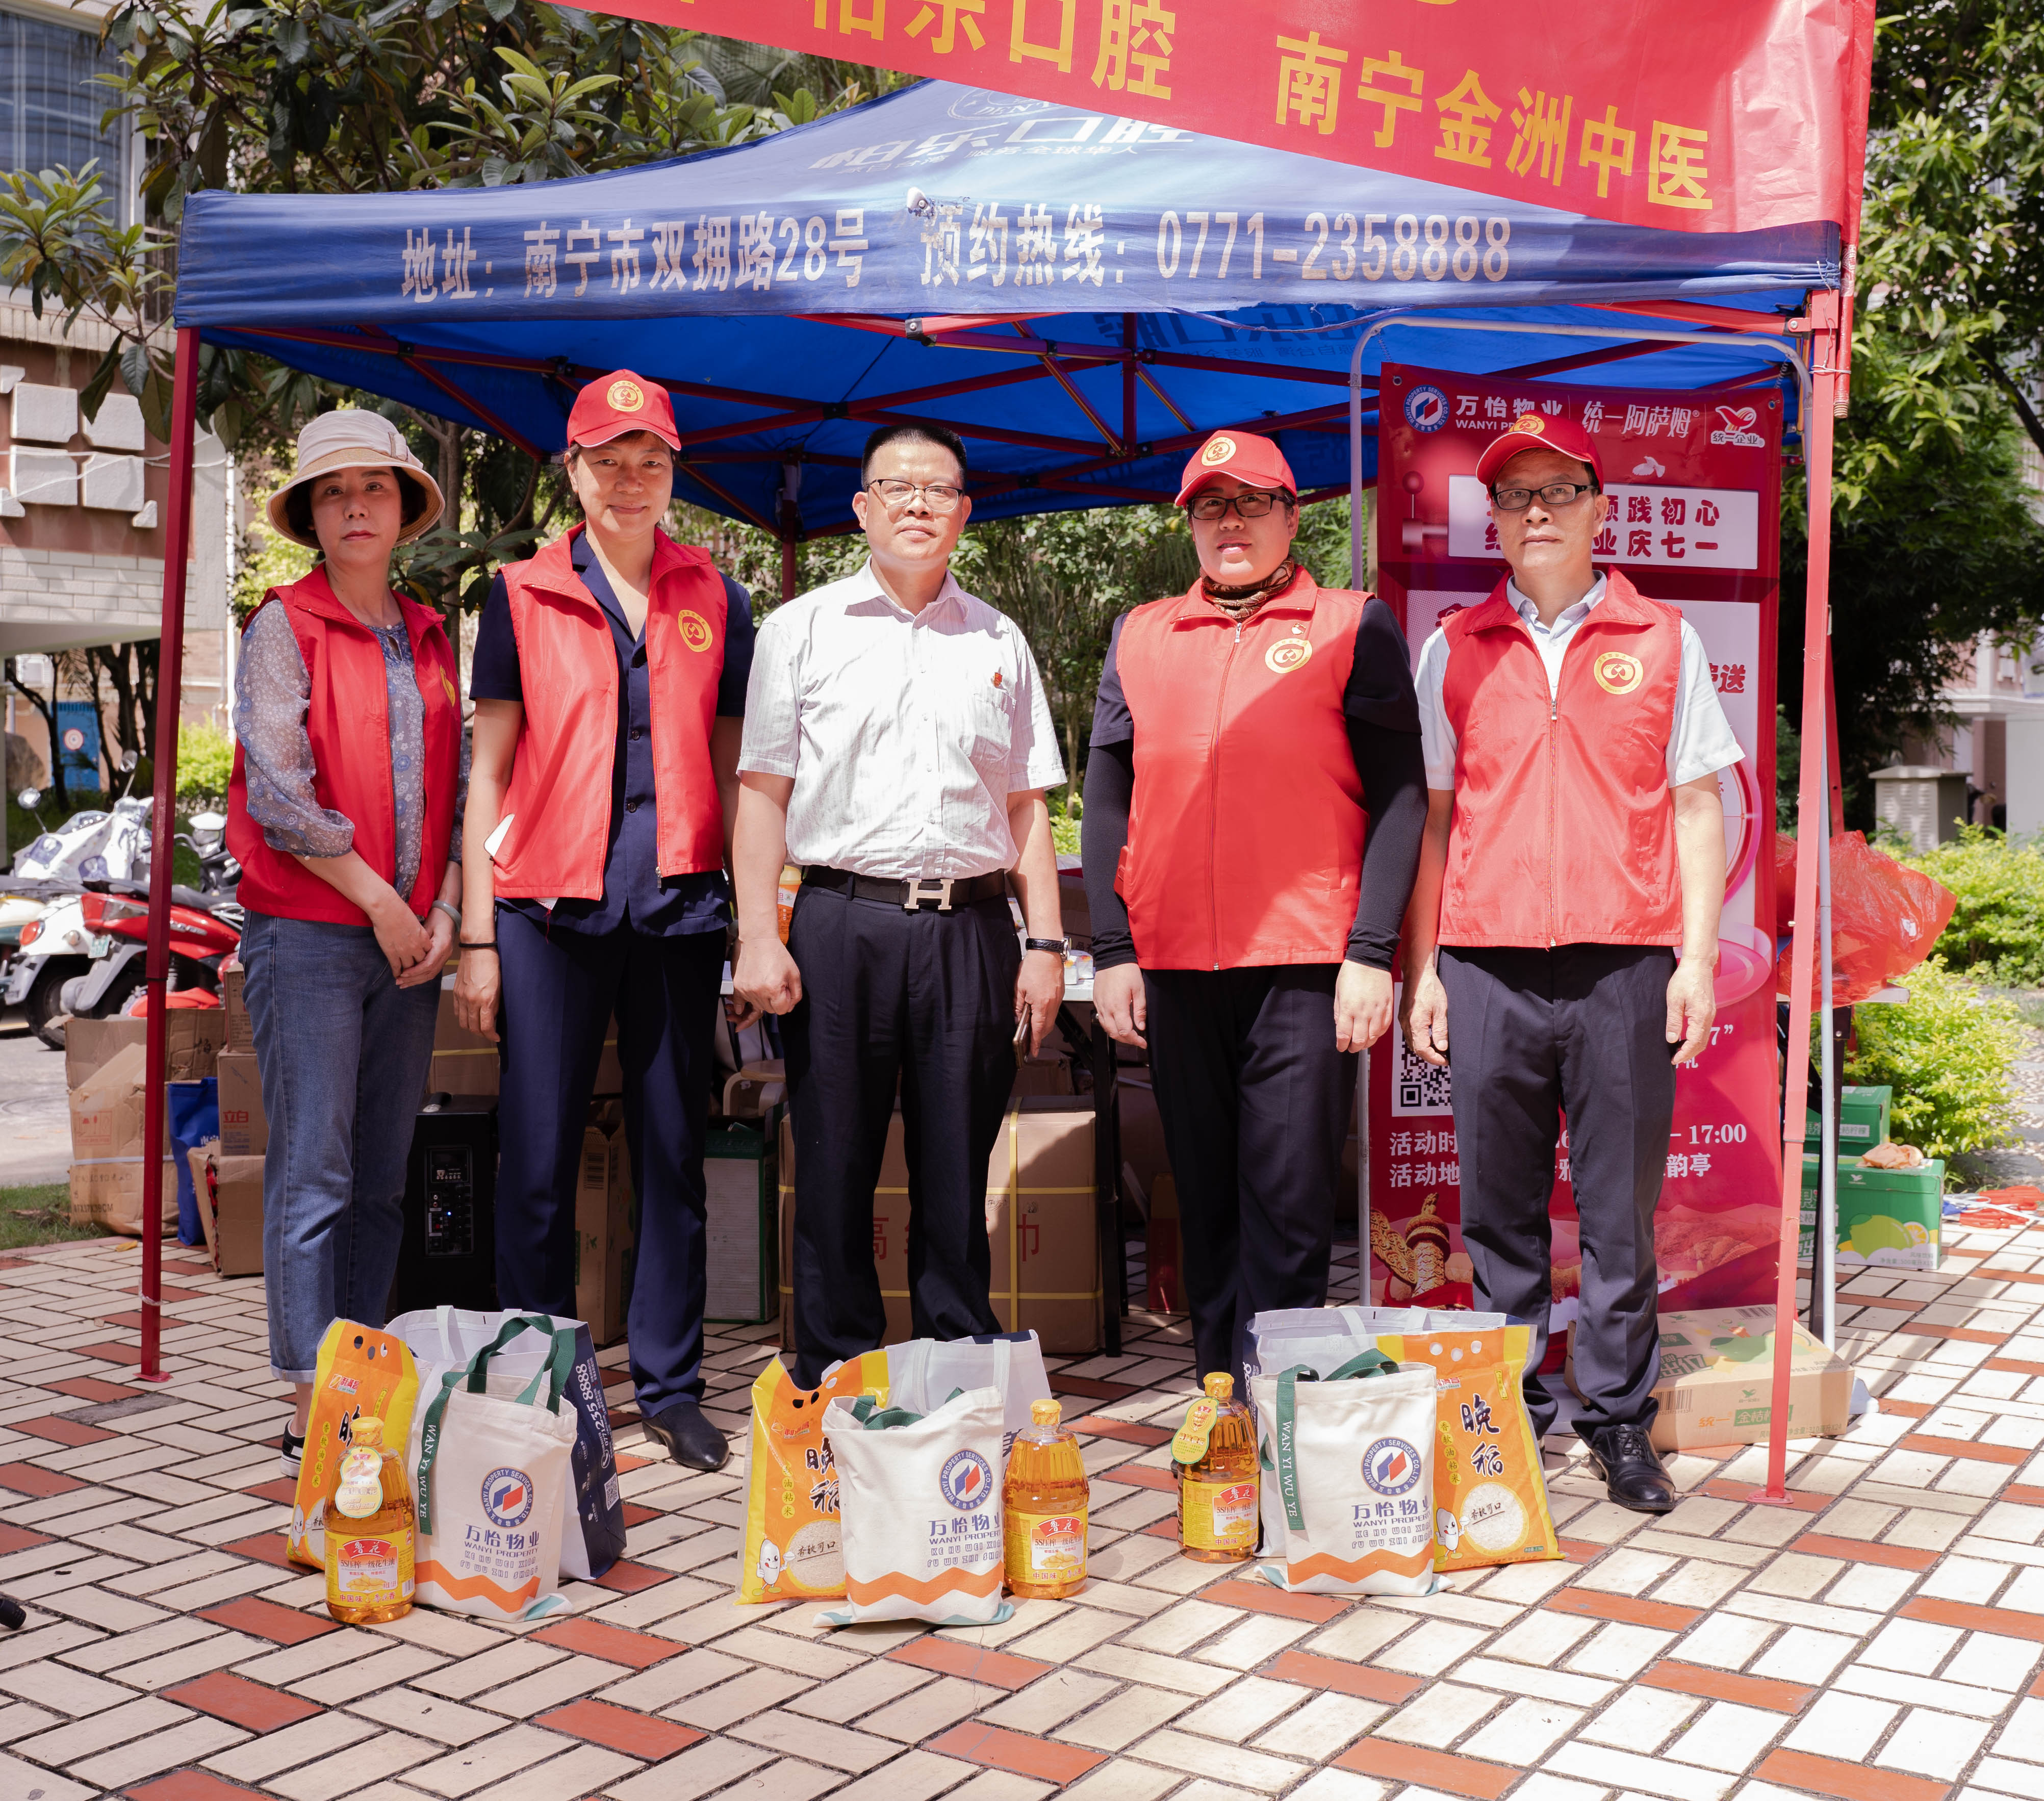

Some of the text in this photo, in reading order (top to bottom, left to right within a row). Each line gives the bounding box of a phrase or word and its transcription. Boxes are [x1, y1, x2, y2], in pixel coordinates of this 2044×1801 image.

[1275, 31, 1714, 210] 南宁金洲中医
[523, 208, 870, 298] 南宁市双拥路28号
[1157, 210, 1512, 282] 0771-2358888
[1406, 387, 1427, 406] PROPERTY
[1427, 387, 1447, 406] SERVICES
[1455, 419, 1497, 431] WANYI
[1581, 400, 1692, 439] 统一阿萨姆
[1711, 432, 1758, 446] 统一企业
[223, 1111, 249, 1123] 立白
[1689, 1123, 1747, 1144] 17:00
[575, 1363, 594, 1401] 8888
[1698, 1416, 1730, 1428] 统一
[1460, 1393, 1504, 1477] 晚稻
[1364, 1441, 1387, 1468] PROPERTY
[1388, 1439, 1416, 1459] SERVICES
[1440, 1422, 1461, 1482] 香软油粘米
[419, 1424, 437, 1518] WAN YI WU YE
[942, 1452, 965, 1479] PROPERTY
[965, 1451, 988, 1472] SERVICES
[1282, 1420, 1298, 1517] WAN YI WU YE
[484, 1469, 509, 1490] PROPERTY
[510, 1470, 532, 1493] SERVICES
[1364, 1469, 1378, 1489] WANYI
[941, 1481, 954, 1502] WANYI
[1230, 1486, 1252, 1500] 鲁花
[482, 1490, 492, 1513] WANYI
[1471, 1502, 1501, 1520] 香软可口
[1048, 1519, 1074, 1532] 鲁花
[1353, 1519, 1387, 1528] WANYI
[1392, 1526, 1412, 1535] WEI
[465, 1524, 540, 1550] 万怡物业
[929, 1536, 961, 1546] WANYI
[1215, 1537, 1238, 1546] 中国味
[1369, 1539, 1385, 1547] WU
[1389, 1537, 1408, 1546] ZHI
[353, 1540, 381, 1555] 鲁花
[464, 1541, 539, 1558] WANYI PROPERTY
[965, 1542, 983, 1552] WEI
[495, 1558, 514, 1568] WEI
[943, 1557, 958, 1567] WU
[962, 1554, 979, 1564] ZHI
[474, 1564, 488, 1574] WU
[492, 1568, 509, 1579] ZHI
[1032, 1571, 1058, 1580] 中国味
[340, 1594, 363, 1603] 中国味
